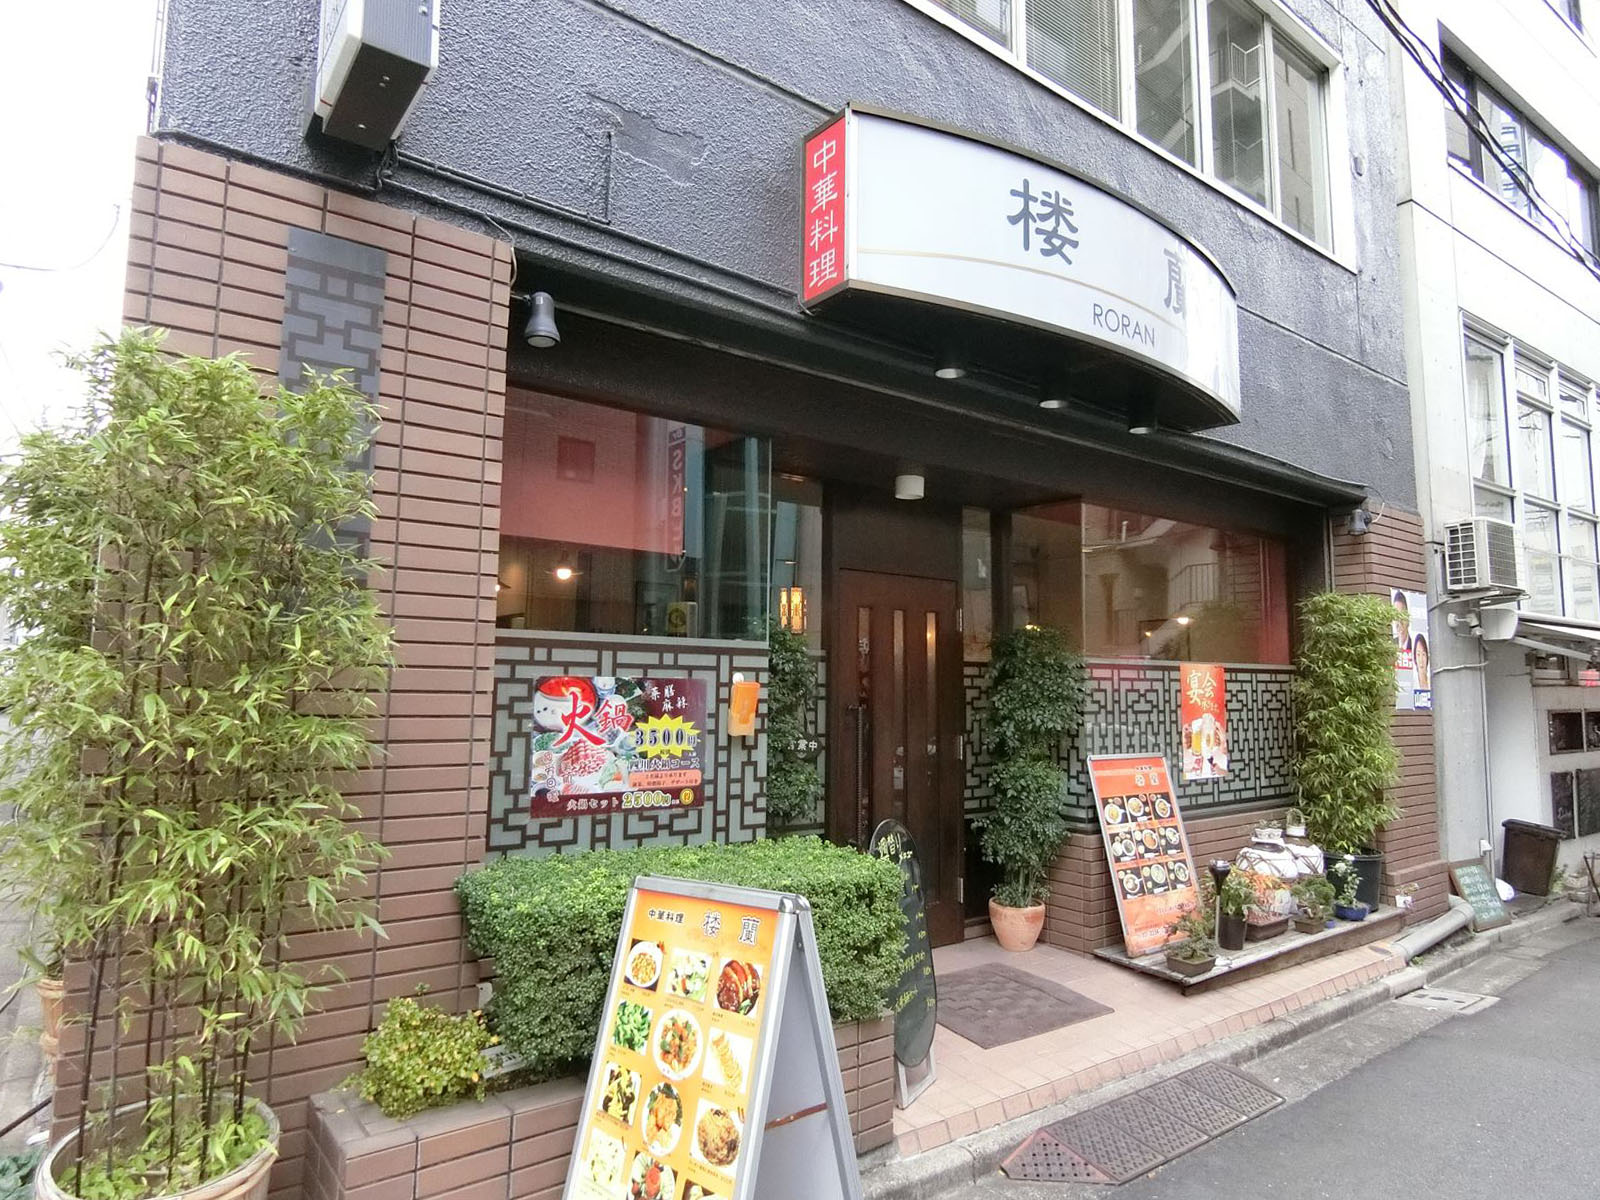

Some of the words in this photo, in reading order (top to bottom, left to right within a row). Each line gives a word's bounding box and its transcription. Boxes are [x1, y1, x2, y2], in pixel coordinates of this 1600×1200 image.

[809, 140, 838, 289] 中華料理
[1093, 303, 1156, 348] RORAN
[1186, 670, 1217, 706] 宴会
[552, 691, 635, 747] 火鍋
[648, 908, 685, 924] 中華料理
